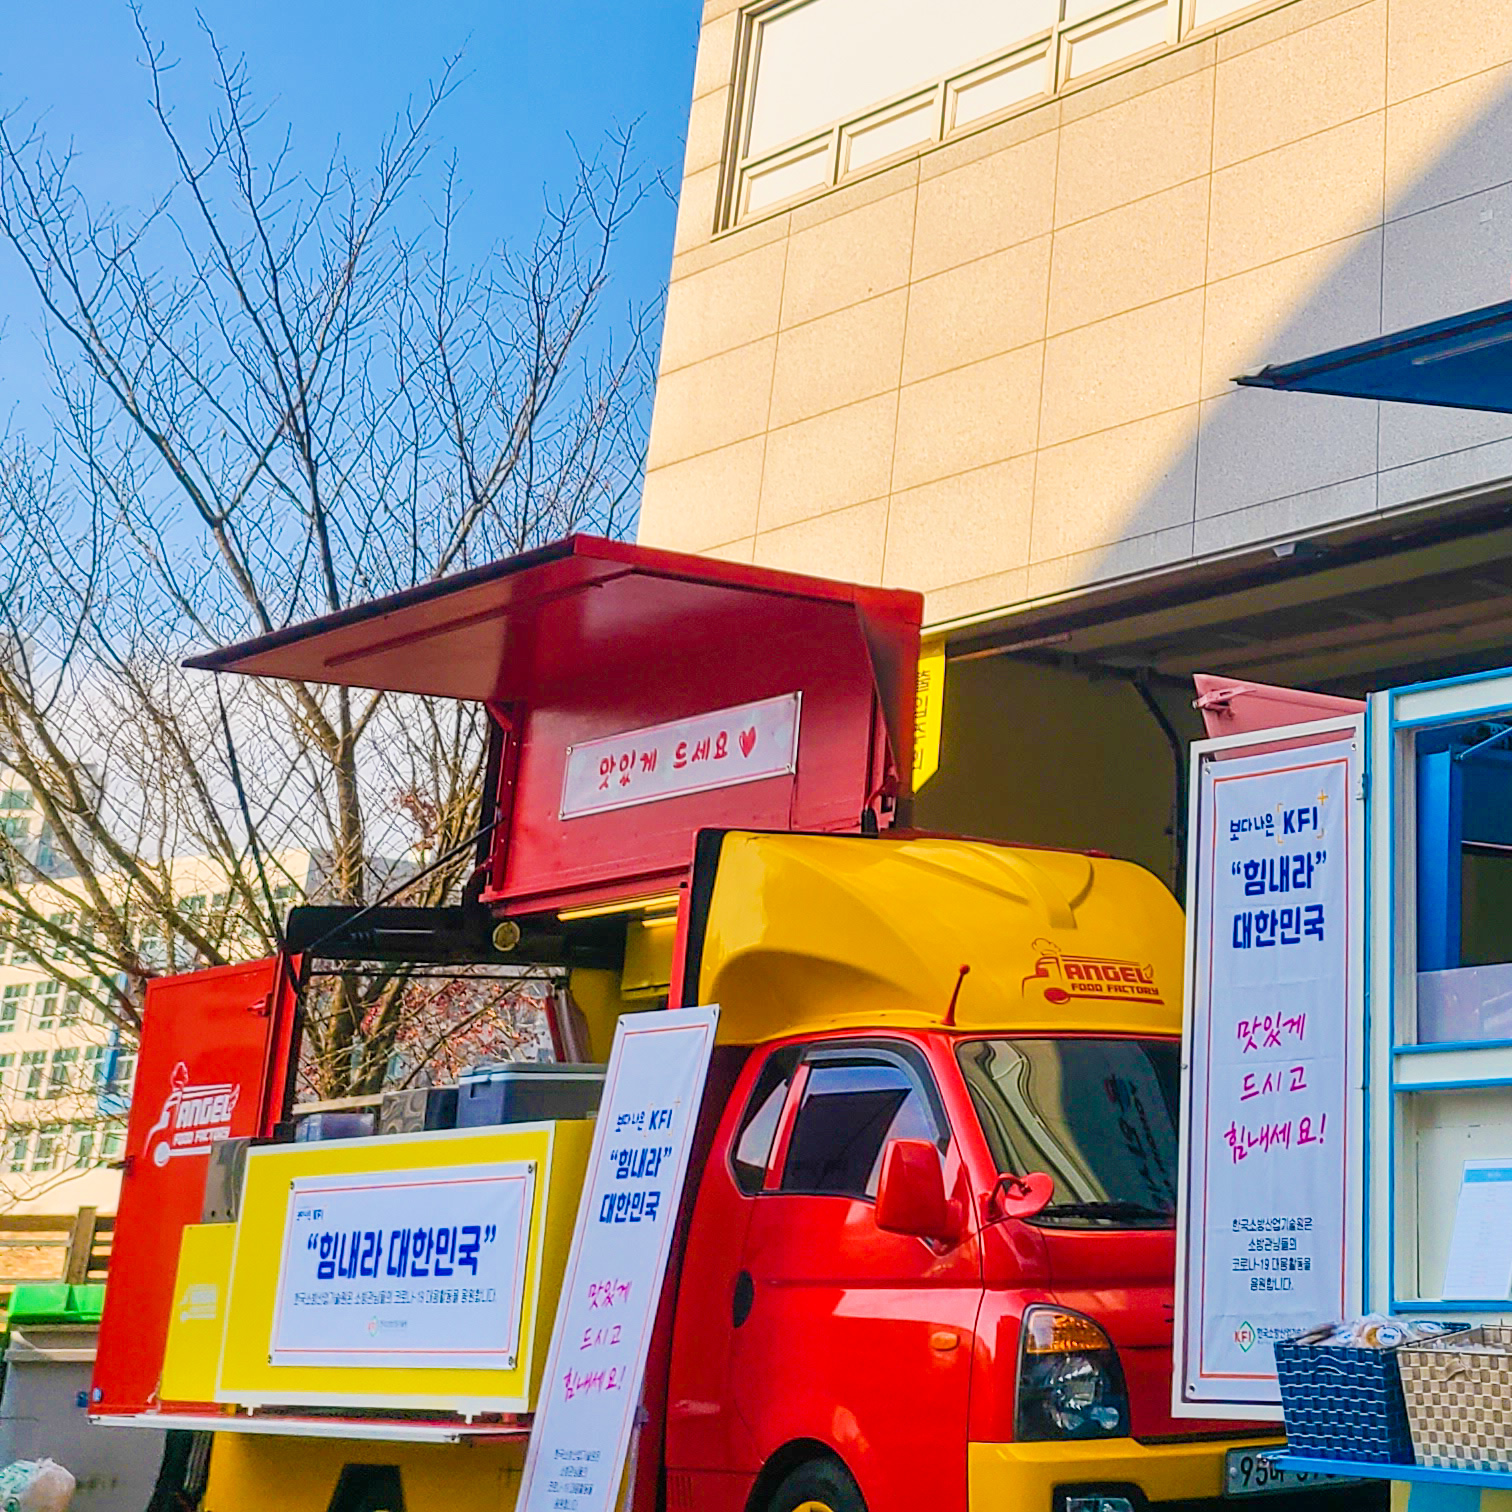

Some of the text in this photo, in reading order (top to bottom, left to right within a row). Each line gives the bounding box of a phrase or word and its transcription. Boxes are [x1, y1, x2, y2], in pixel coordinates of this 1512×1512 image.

[598, 730, 729, 790] 맛있게 드세요
[1283, 806, 1318, 835] KFI
[1231, 850, 1327, 897] “힘내라”
[1232, 904, 1325, 949] 대한민국
[1063, 963, 1153, 985] ANGEL
[1071, 983, 1160, 996] FOOD FACTORY
[1237, 1011, 1306, 1054] 맛있게
[1240, 1066, 1307, 1102] 드시고
[175, 1094, 232, 1129] ANGEL
[648, 1109, 673, 1131] KFI
[1223, 1112, 1327, 1165] 힘내세요!
[610, 1146, 673, 1180] “힘내라”
[599, 1191, 662, 1224] 대한민국
[1232, 1217, 1313, 1232] 한국소방산업기술원은
[307, 1224, 497, 1280] “힘내라 대한민국”
[1232, 1257, 1270, 1271] 코로나-19
[588, 1279, 632, 1310] 맛있게
[580, 1325, 622, 1350] 드시고
[1234, 1330, 1252, 1343] KFI
[563, 1365, 627, 1403] 힘내세요!
